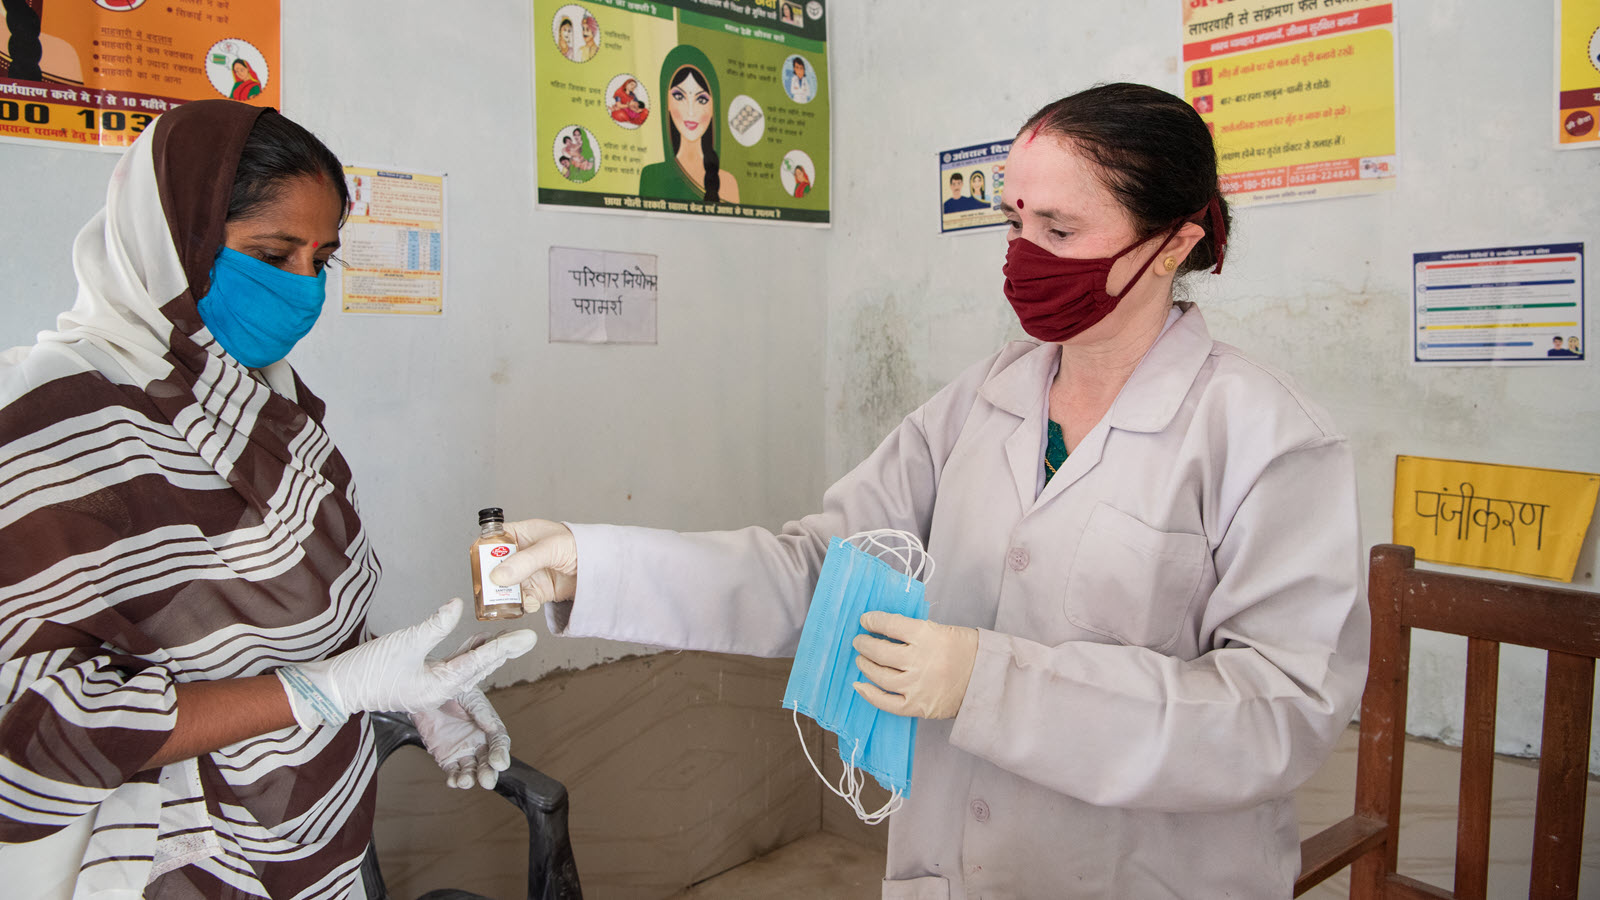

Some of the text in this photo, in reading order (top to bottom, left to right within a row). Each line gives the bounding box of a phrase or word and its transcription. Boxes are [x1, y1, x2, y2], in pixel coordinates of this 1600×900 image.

[1188, 12, 1234, 36] लापरवाही
[1238, 9, 1250, 25] से
[1253, 2, 1294, 22] संक्रमण
[101, 26, 132, 38] माहवारी
[101, 40, 132, 51] माहवारी
[101, 54, 132, 64] माहवारी
[1302, 52, 1314, 66] दूरी
[102, 67, 132, 78] माहवारी
[51, 89, 77, 102] करने
[106, 94, 117, 106] से
[122, 98, 136, 107] 10
[140, 98, 167, 110] महीने
[952, 148, 988, 162] अंतराल
[990, 144, 1012, 155] दिव
[624, 196, 642, 208] गोली
[568, 266, 620, 289] परिवार
[572, 294, 624, 316] परामर्श
[1414, 482, 1551, 551] पंजीकरण
